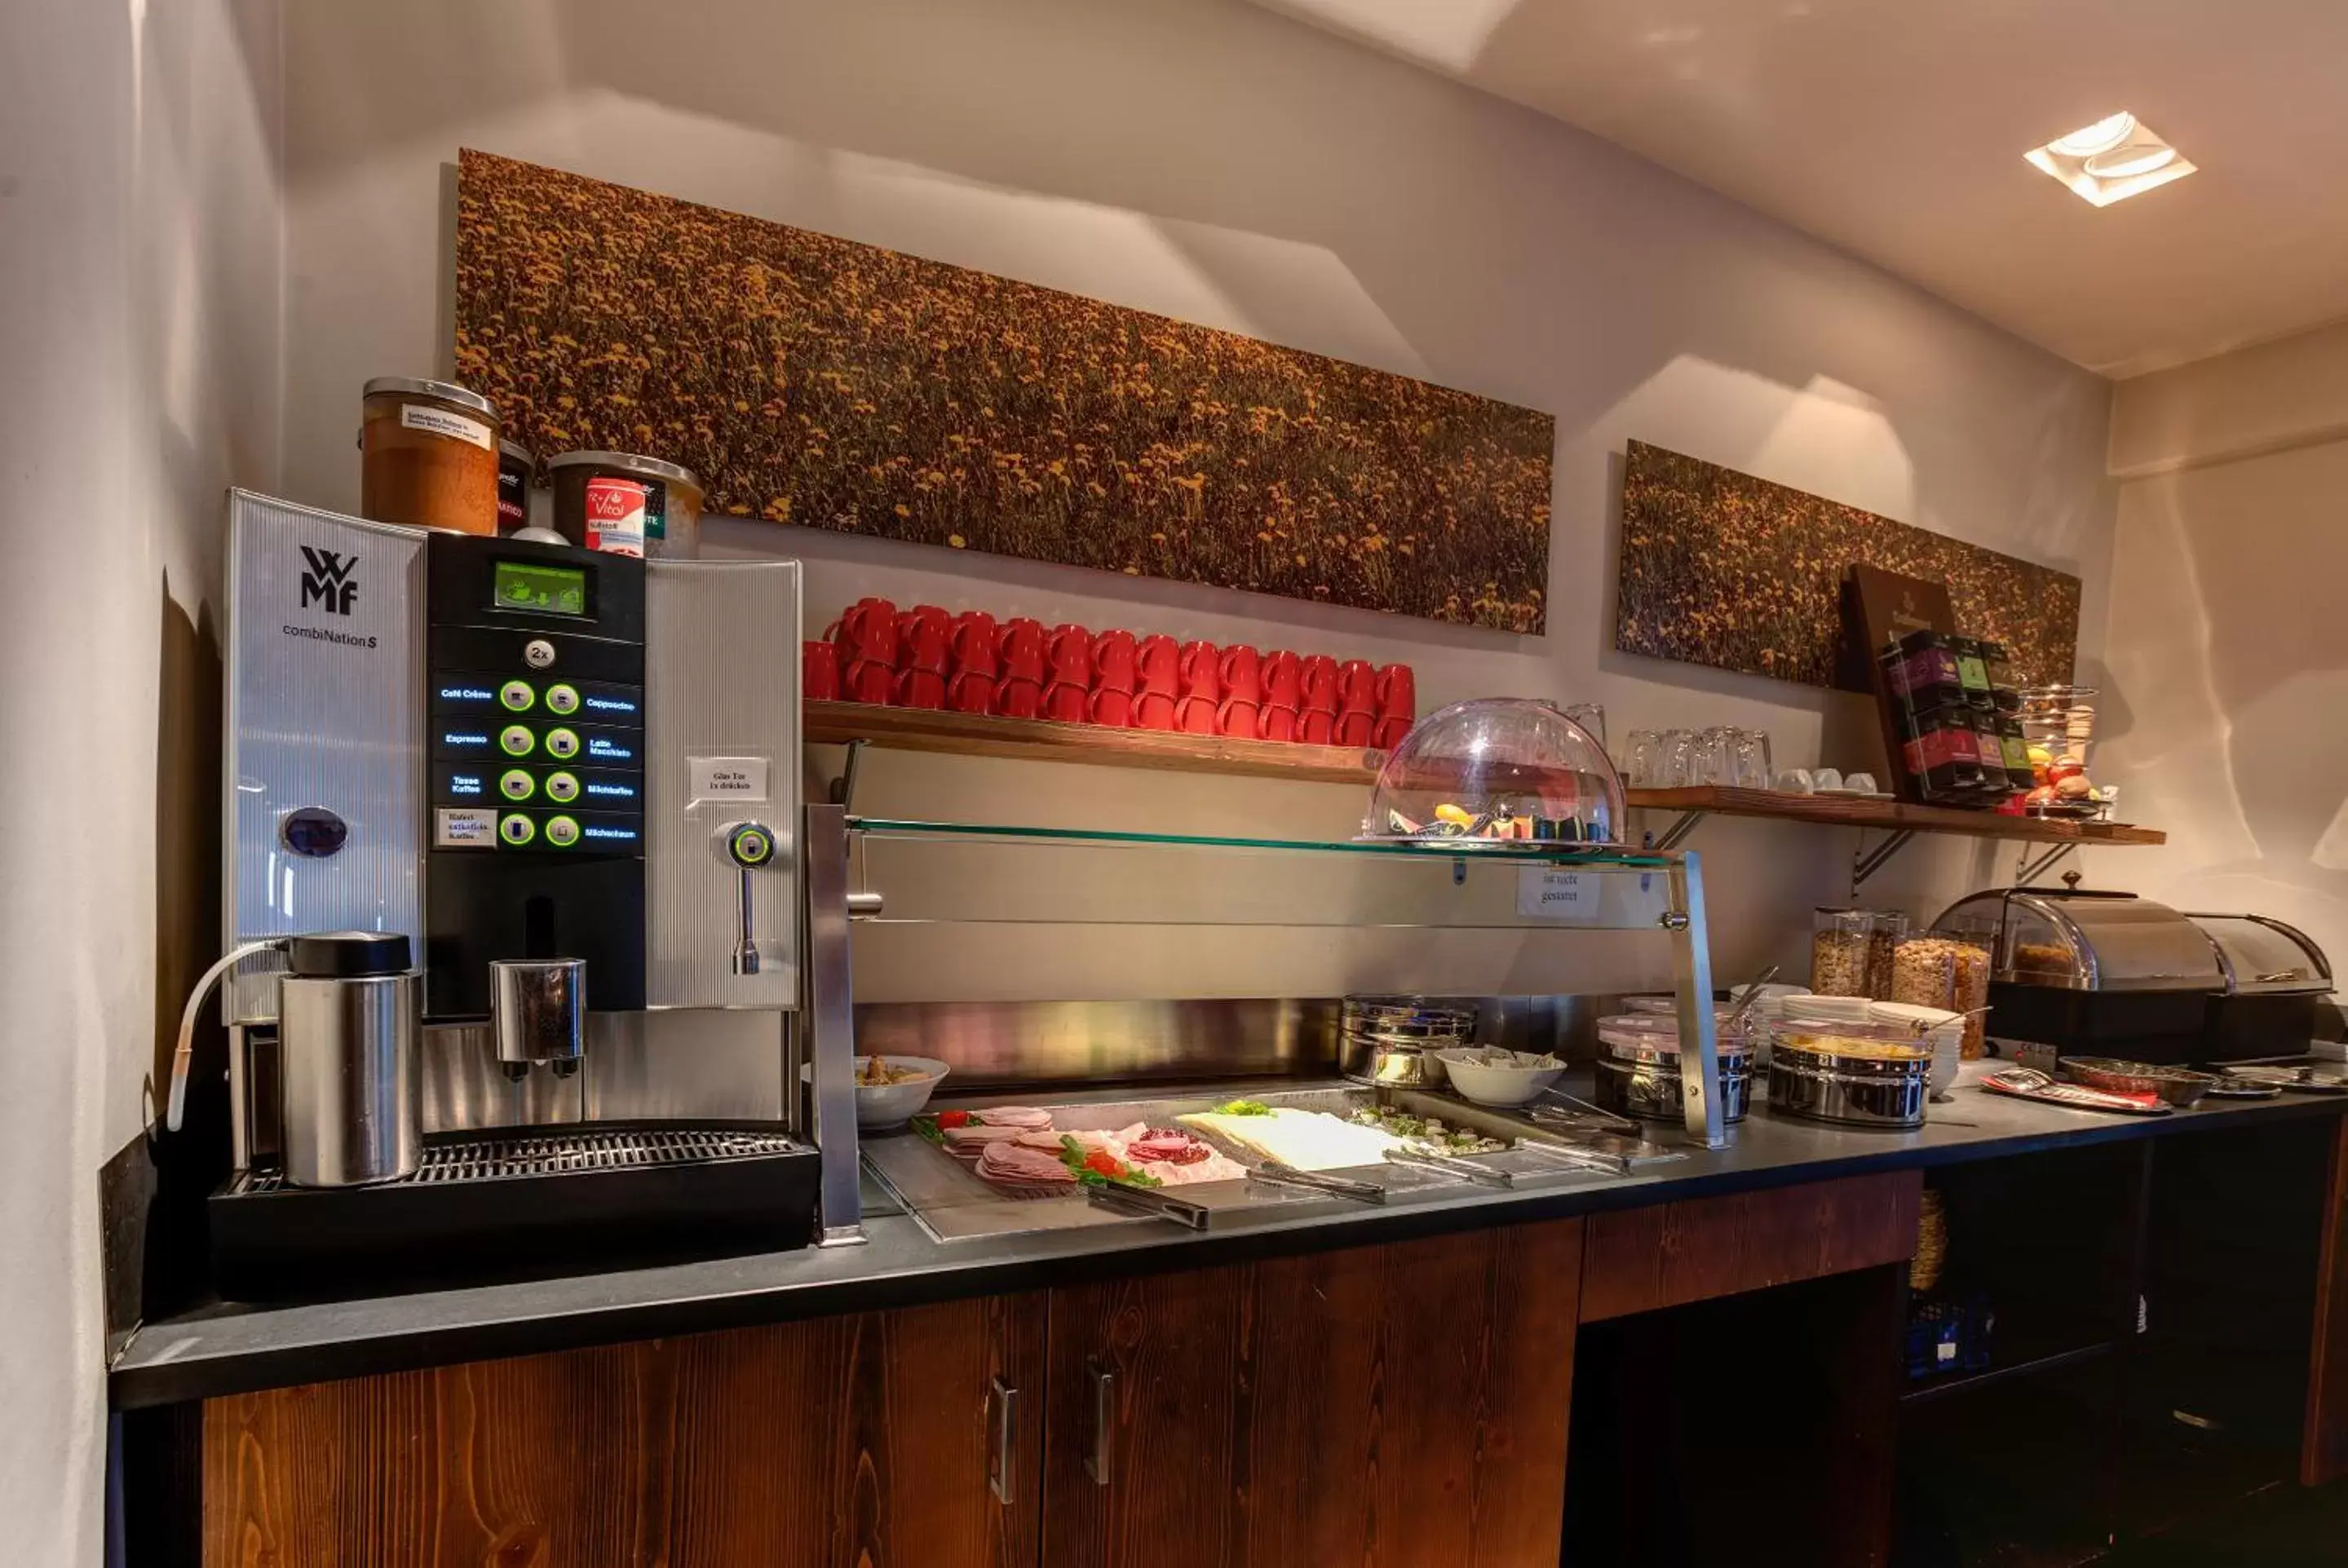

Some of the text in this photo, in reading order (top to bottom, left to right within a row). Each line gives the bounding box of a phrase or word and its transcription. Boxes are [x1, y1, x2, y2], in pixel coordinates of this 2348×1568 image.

[596, 490, 624, 515] Vital
[300, 545, 359, 616] WMF
[532, 647, 548, 660] 2x
